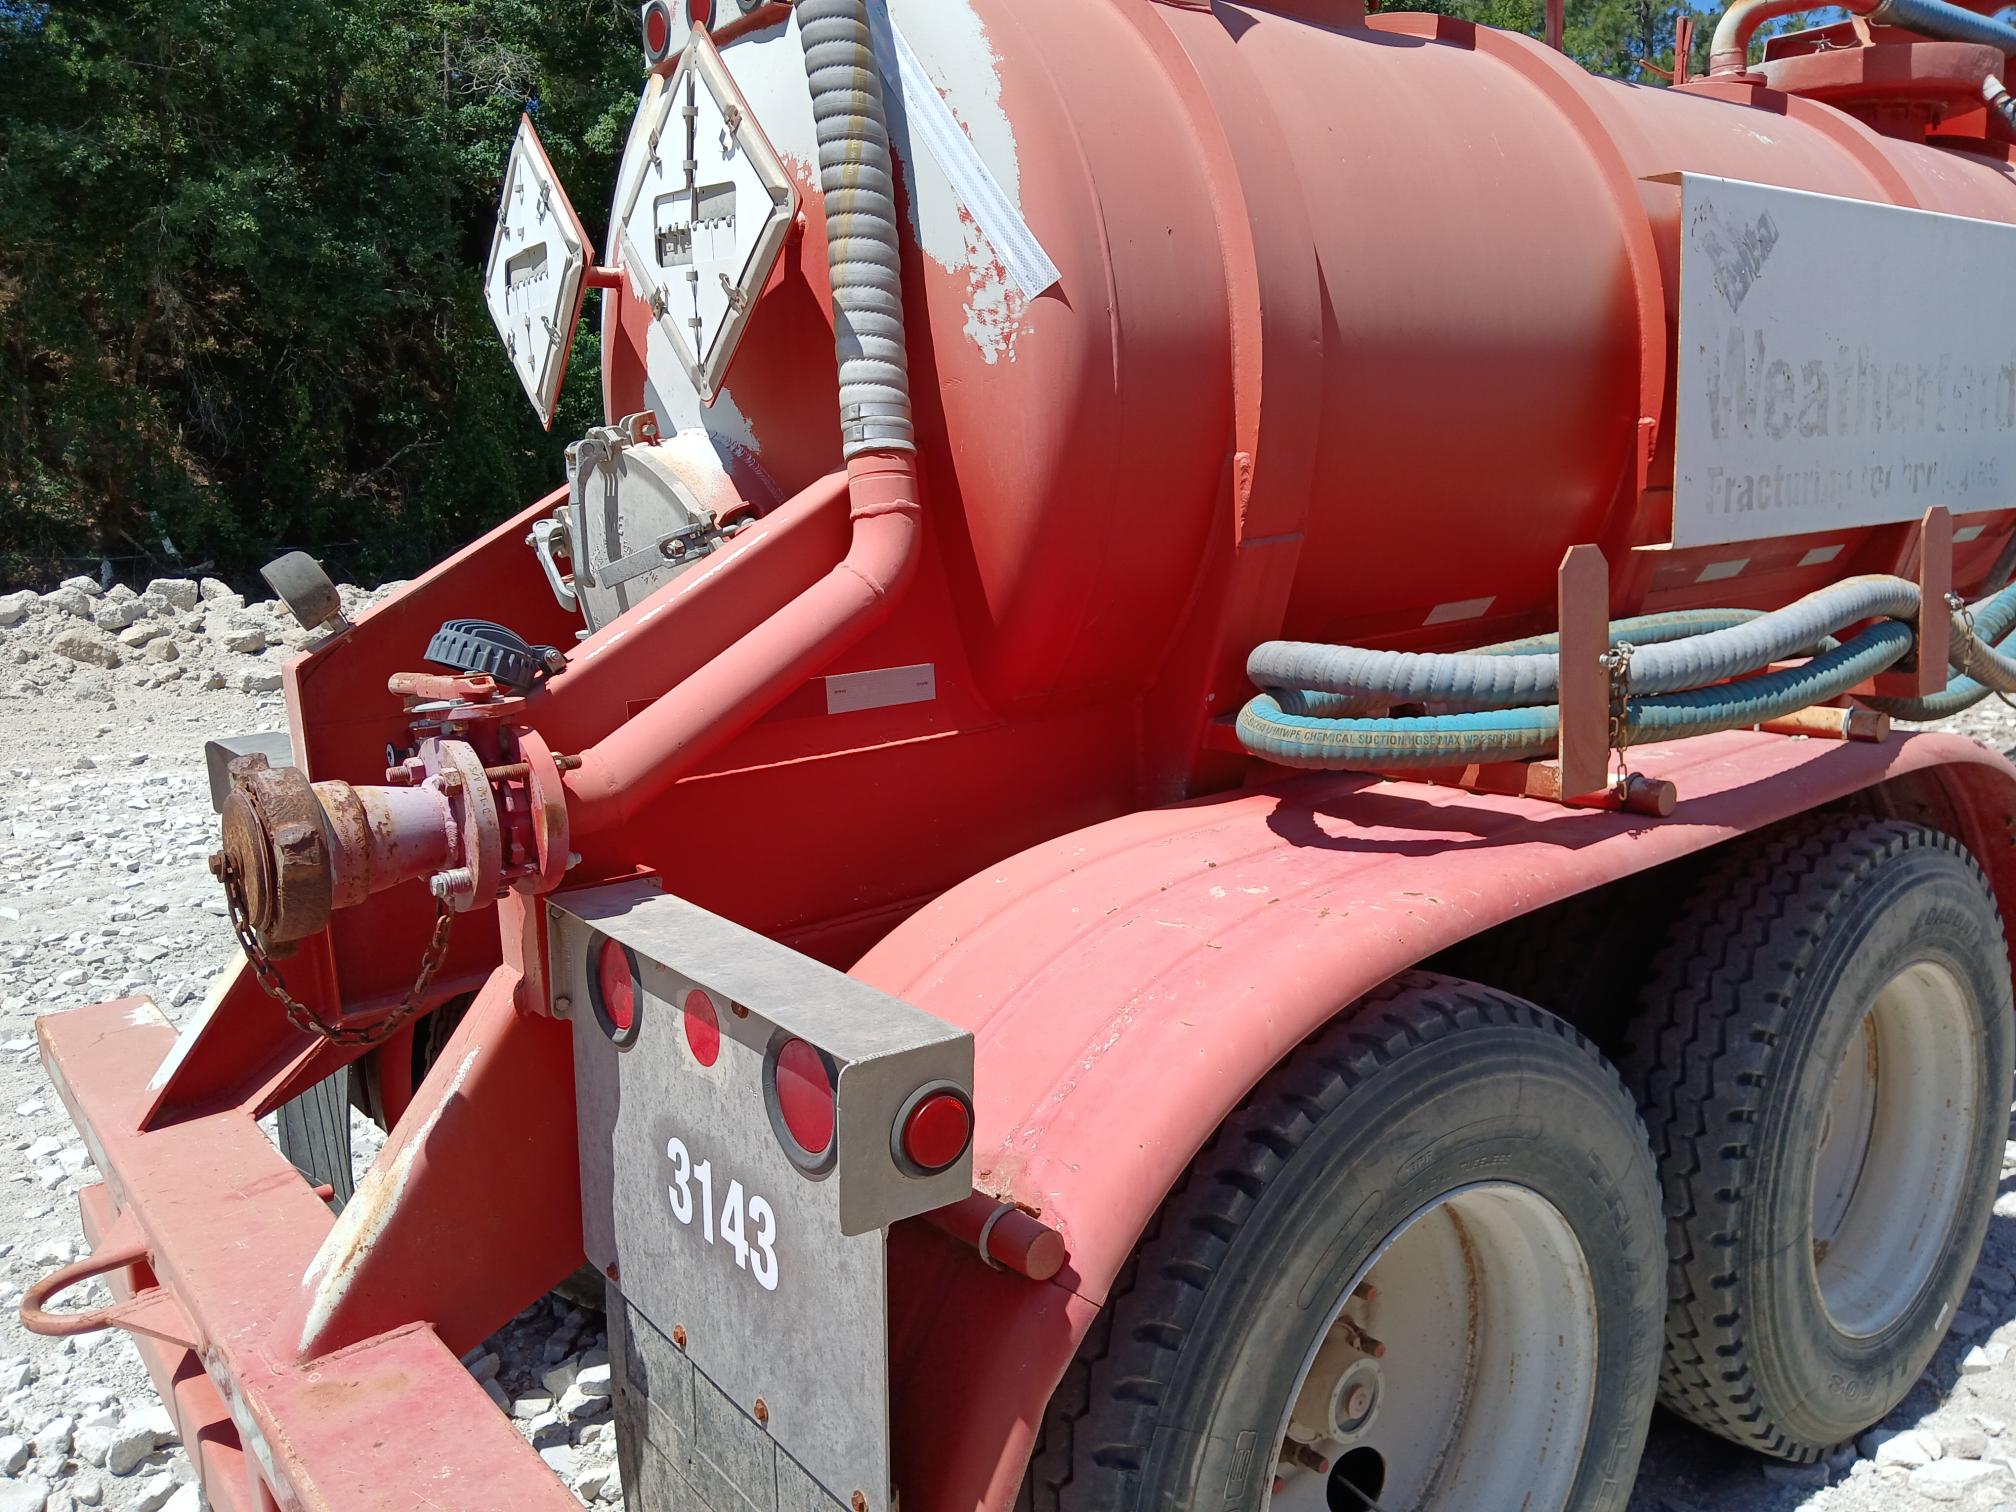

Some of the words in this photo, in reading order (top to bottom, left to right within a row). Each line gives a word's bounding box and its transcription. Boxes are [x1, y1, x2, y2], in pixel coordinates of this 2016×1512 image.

[1303, 731, 1356, 744] CHEMICAL
[1358, 735, 1406, 746] SUCTION
[1408, 735, 1436, 746] HOSE
[1438, 735, 1461, 746] MAX
[667, 1137, 779, 1290] 3143
